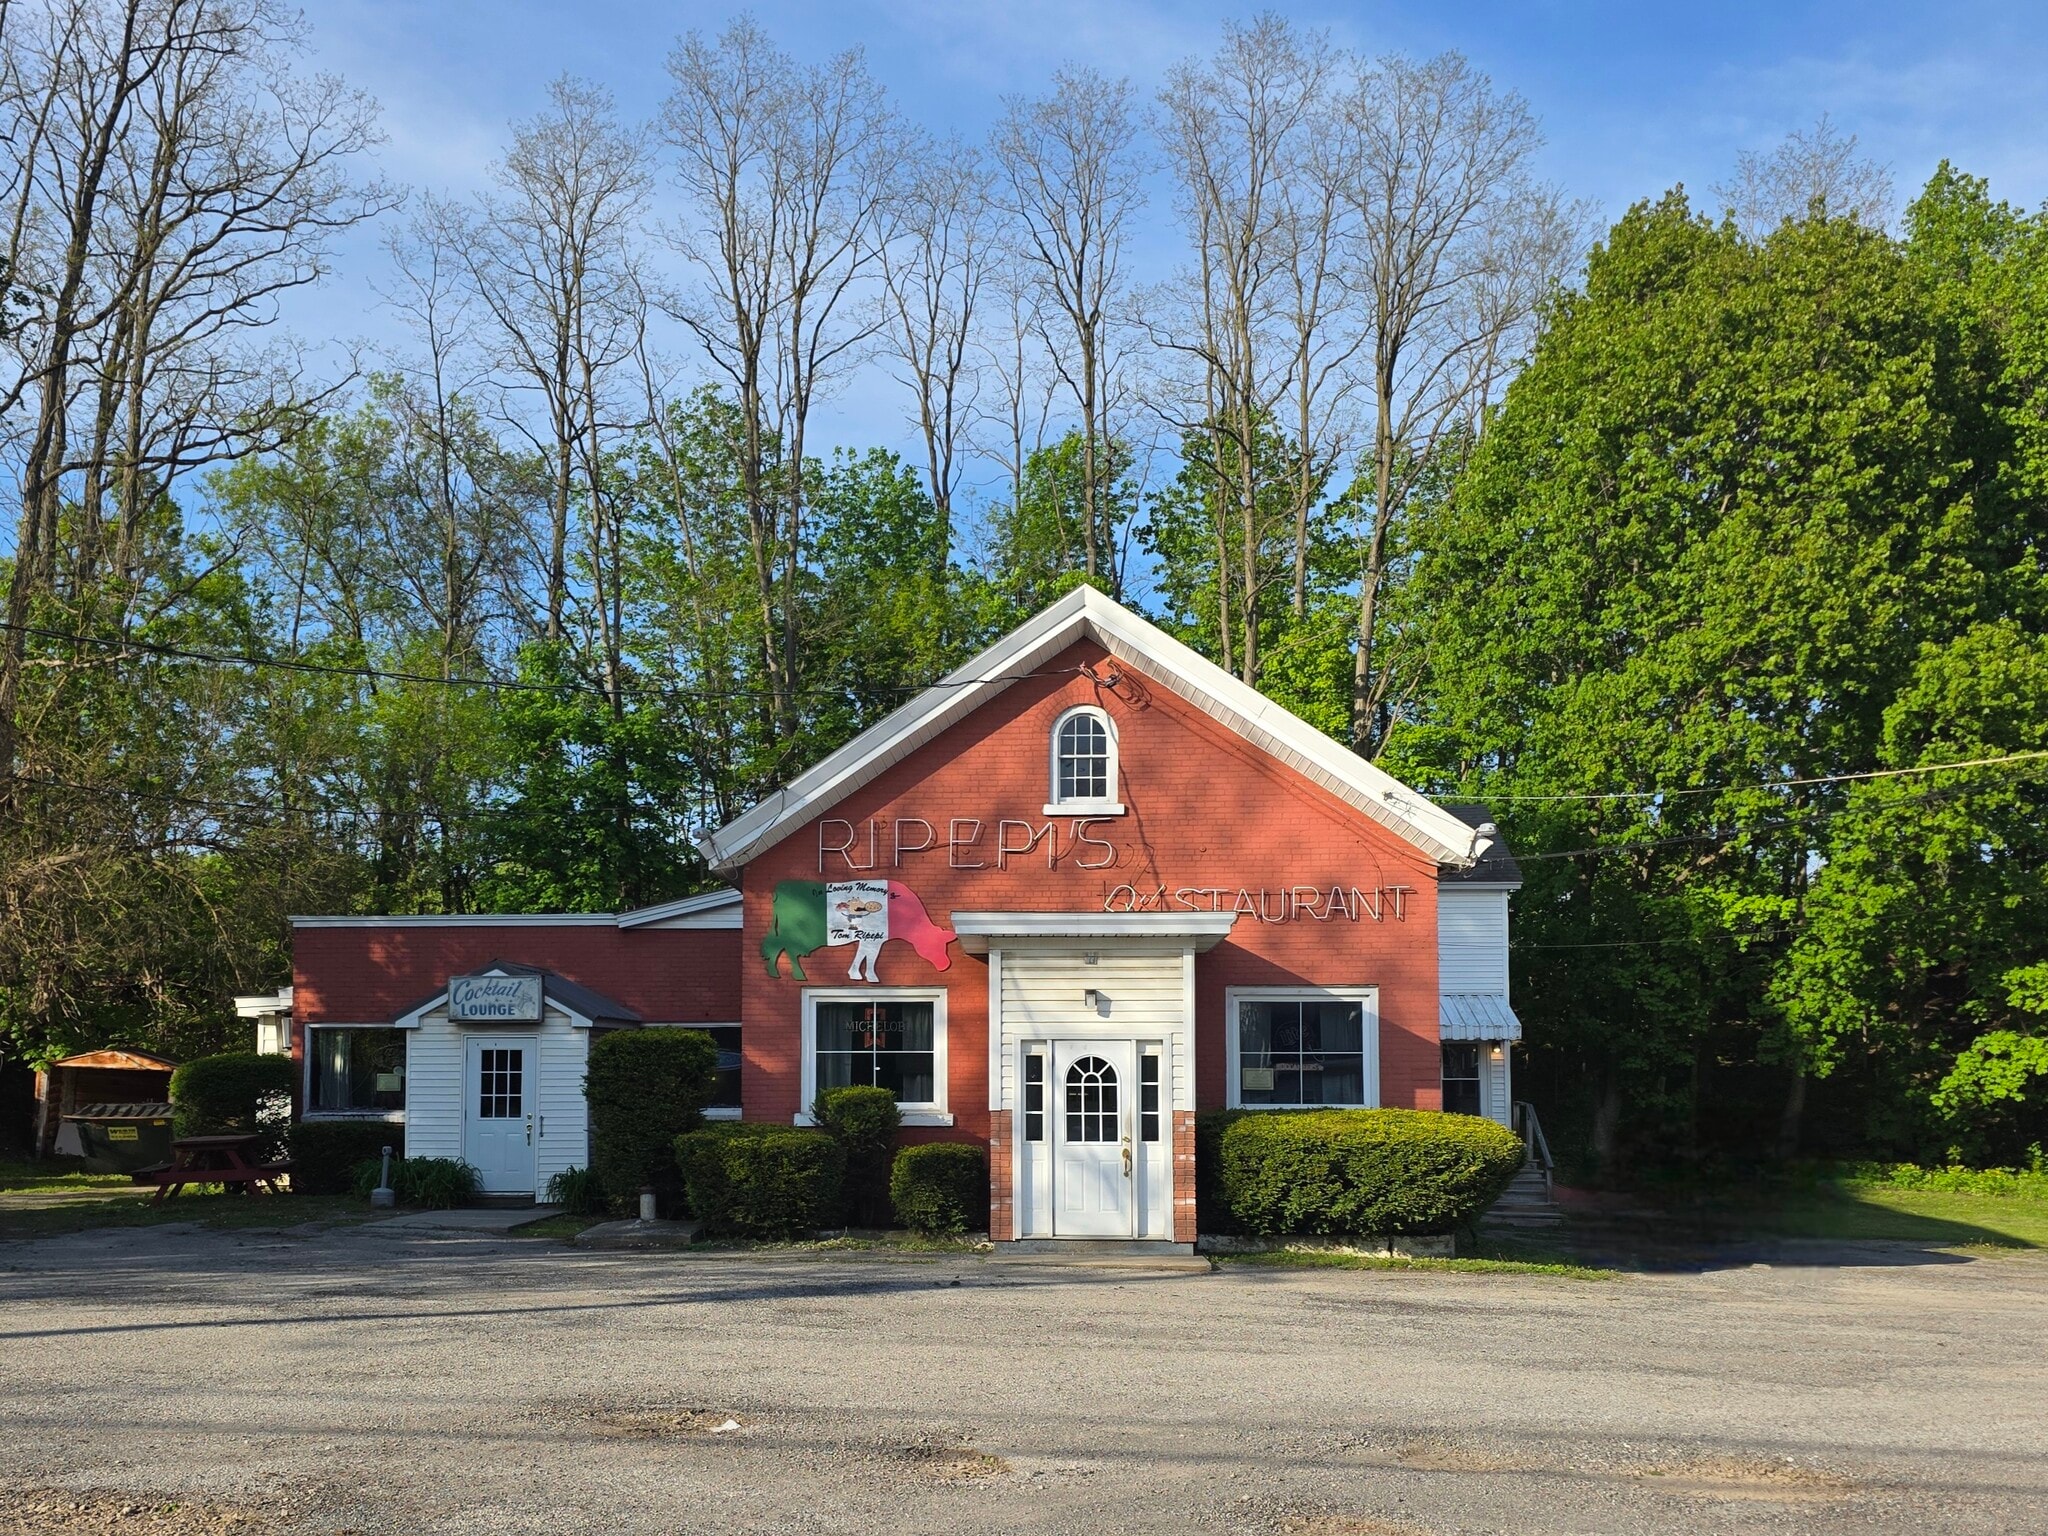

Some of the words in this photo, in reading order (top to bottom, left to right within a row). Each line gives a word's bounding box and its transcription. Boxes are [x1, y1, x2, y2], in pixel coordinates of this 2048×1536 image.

[825, 884, 853, 894] Loving
[855, 882, 889, 896] Memory
[831, 929, 850, 939] Tom
[854, 929, 885, 941] Ripepi
[453, 978, 523, 1005] Cocktail
